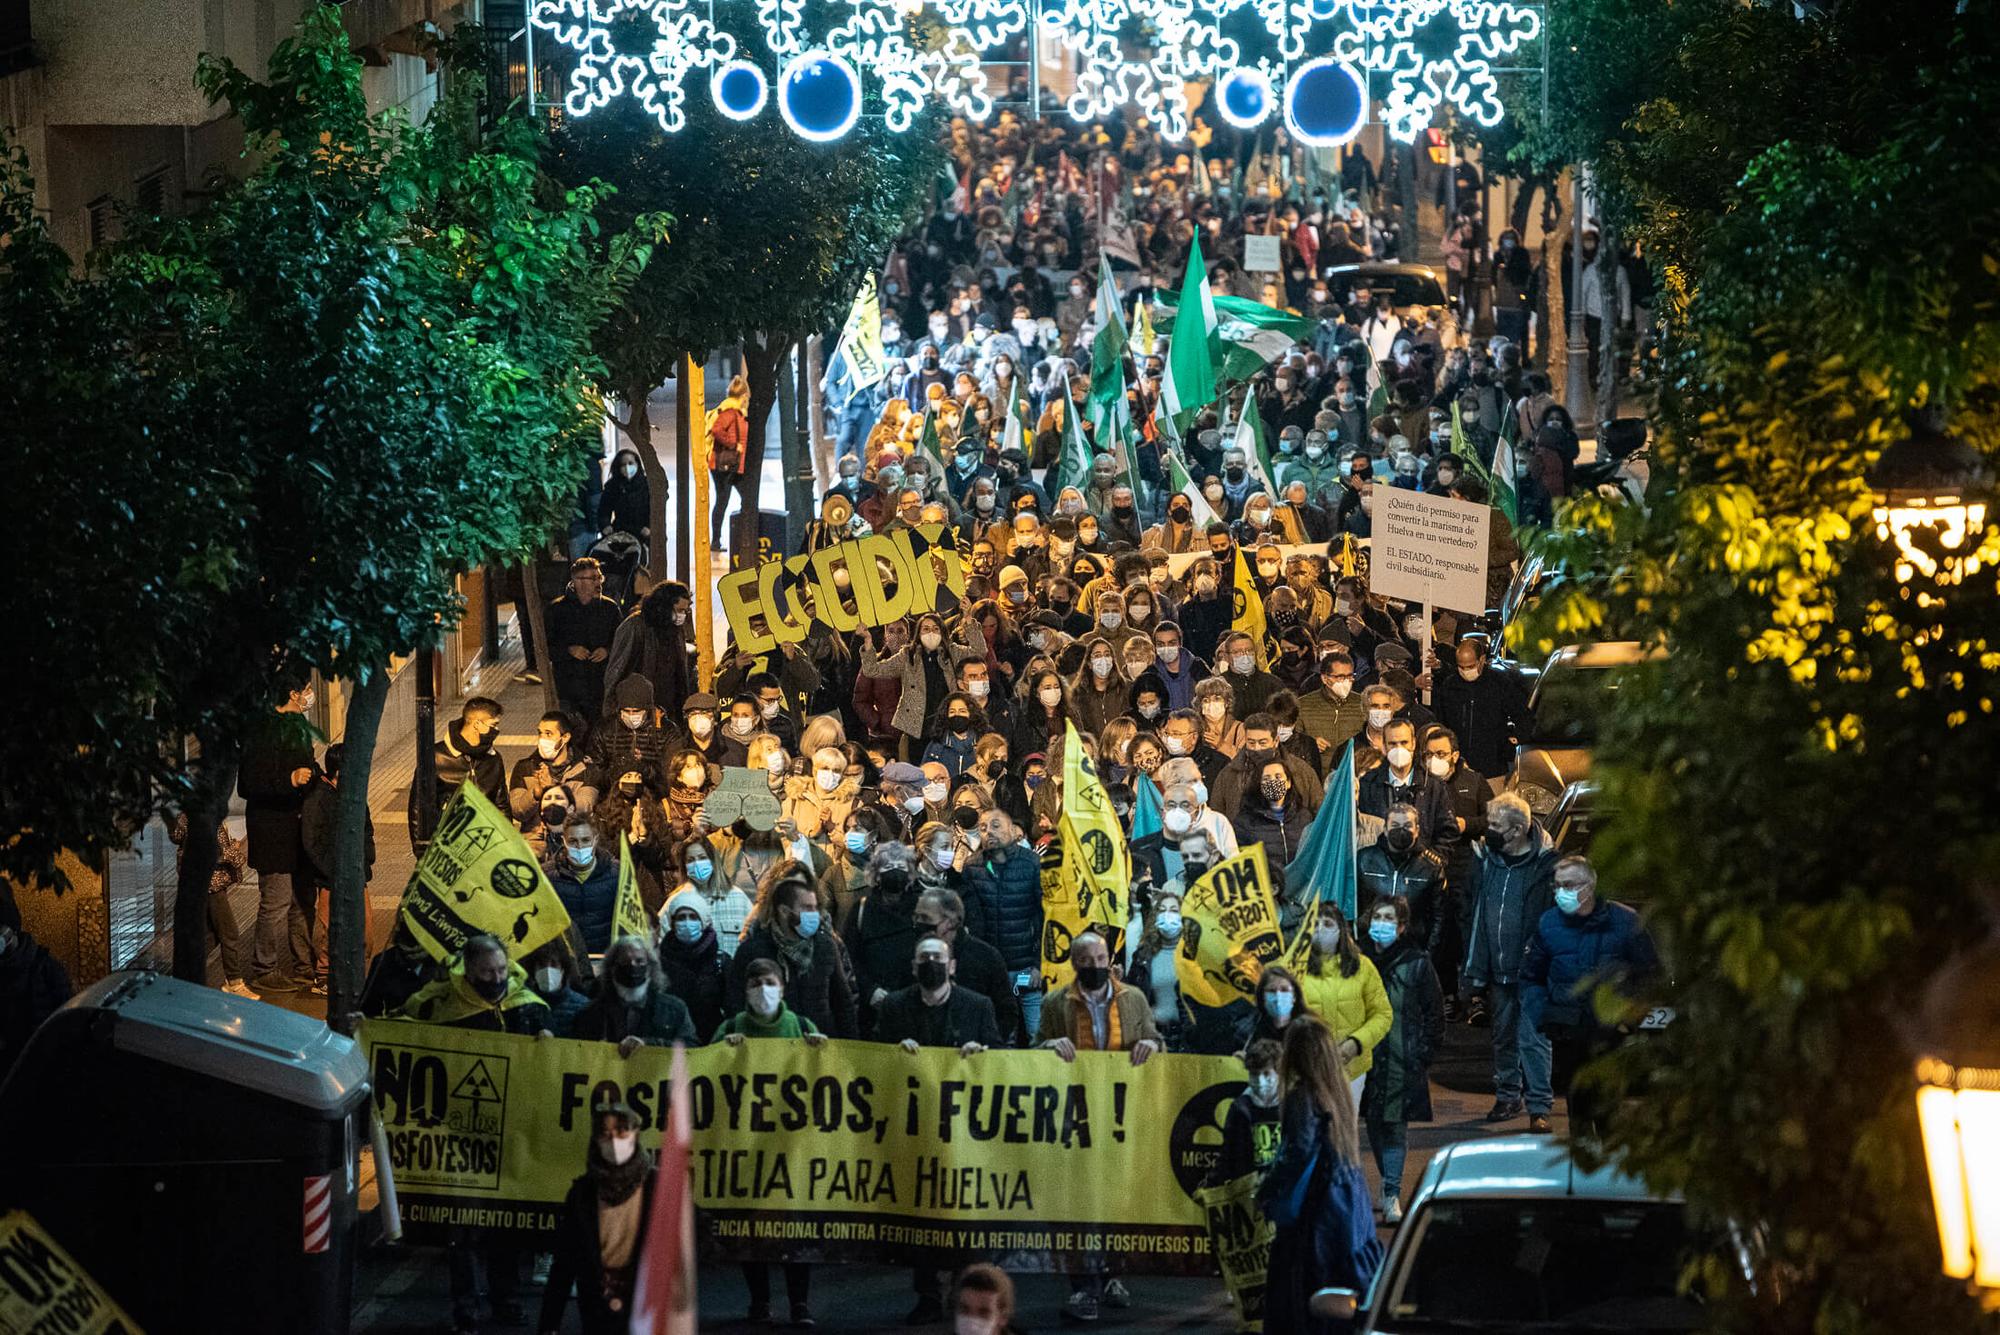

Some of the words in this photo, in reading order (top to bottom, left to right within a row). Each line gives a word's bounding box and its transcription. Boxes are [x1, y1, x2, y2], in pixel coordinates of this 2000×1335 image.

[1388, 497, 1415, 511] ¿Quién
[1416, 503, 1428, 513] dio
[1430, 507, 1460, 519] permiso
[1462, 513, 1479, 524] para
[1388, 512, 1420, 526] convertir
[1422, 516, 1429, 527] la
[1431, 520, 1464, 534] marisma
[1464, 525, 1475, 536] de
[1387, 523, 1414, 537] Huelva
[1416, 531, 1425, 539] en
[1426, 534, 1437, 542] un
[1438, 536, 1478, 550] vertedero?
[1386, 561, 1402, 572] civil
[1402, 564, 1446, 580] subsidiario.
[1398, 548, 1434, 566] ESTADO,
[1435, 558, 1480, 574] responsable
[374, 1048, 448, 1129] NO
[939, 1081, 1092, 1150] FUERA
[808, 1156, 898, 1204] PARA
[410, 1204, 513, 1228] CUMPLIMIENTO
[517, 1211, 535, 1229] DE
[538, 1213, 556, 1232] LA
[754, 1220, 820, 1240] NACIONAL
[823, 1222, 876, 1240] CONTRA
[880, 1224, 954, 1248] FERTIBERIA
[958, 1232, 968, 1249] Y
[970, 1232, 986, 1249] LA
[989, 1232, 1050, 1250] RETIRADA
[1056, 1233, 1074, 1250] DE
[1078, 1233, 1102, 1251] LOS
[1106, 1234, 1190, 1252] FOSFOYESOS
[1194, 1236, 1212, 1254] DE
